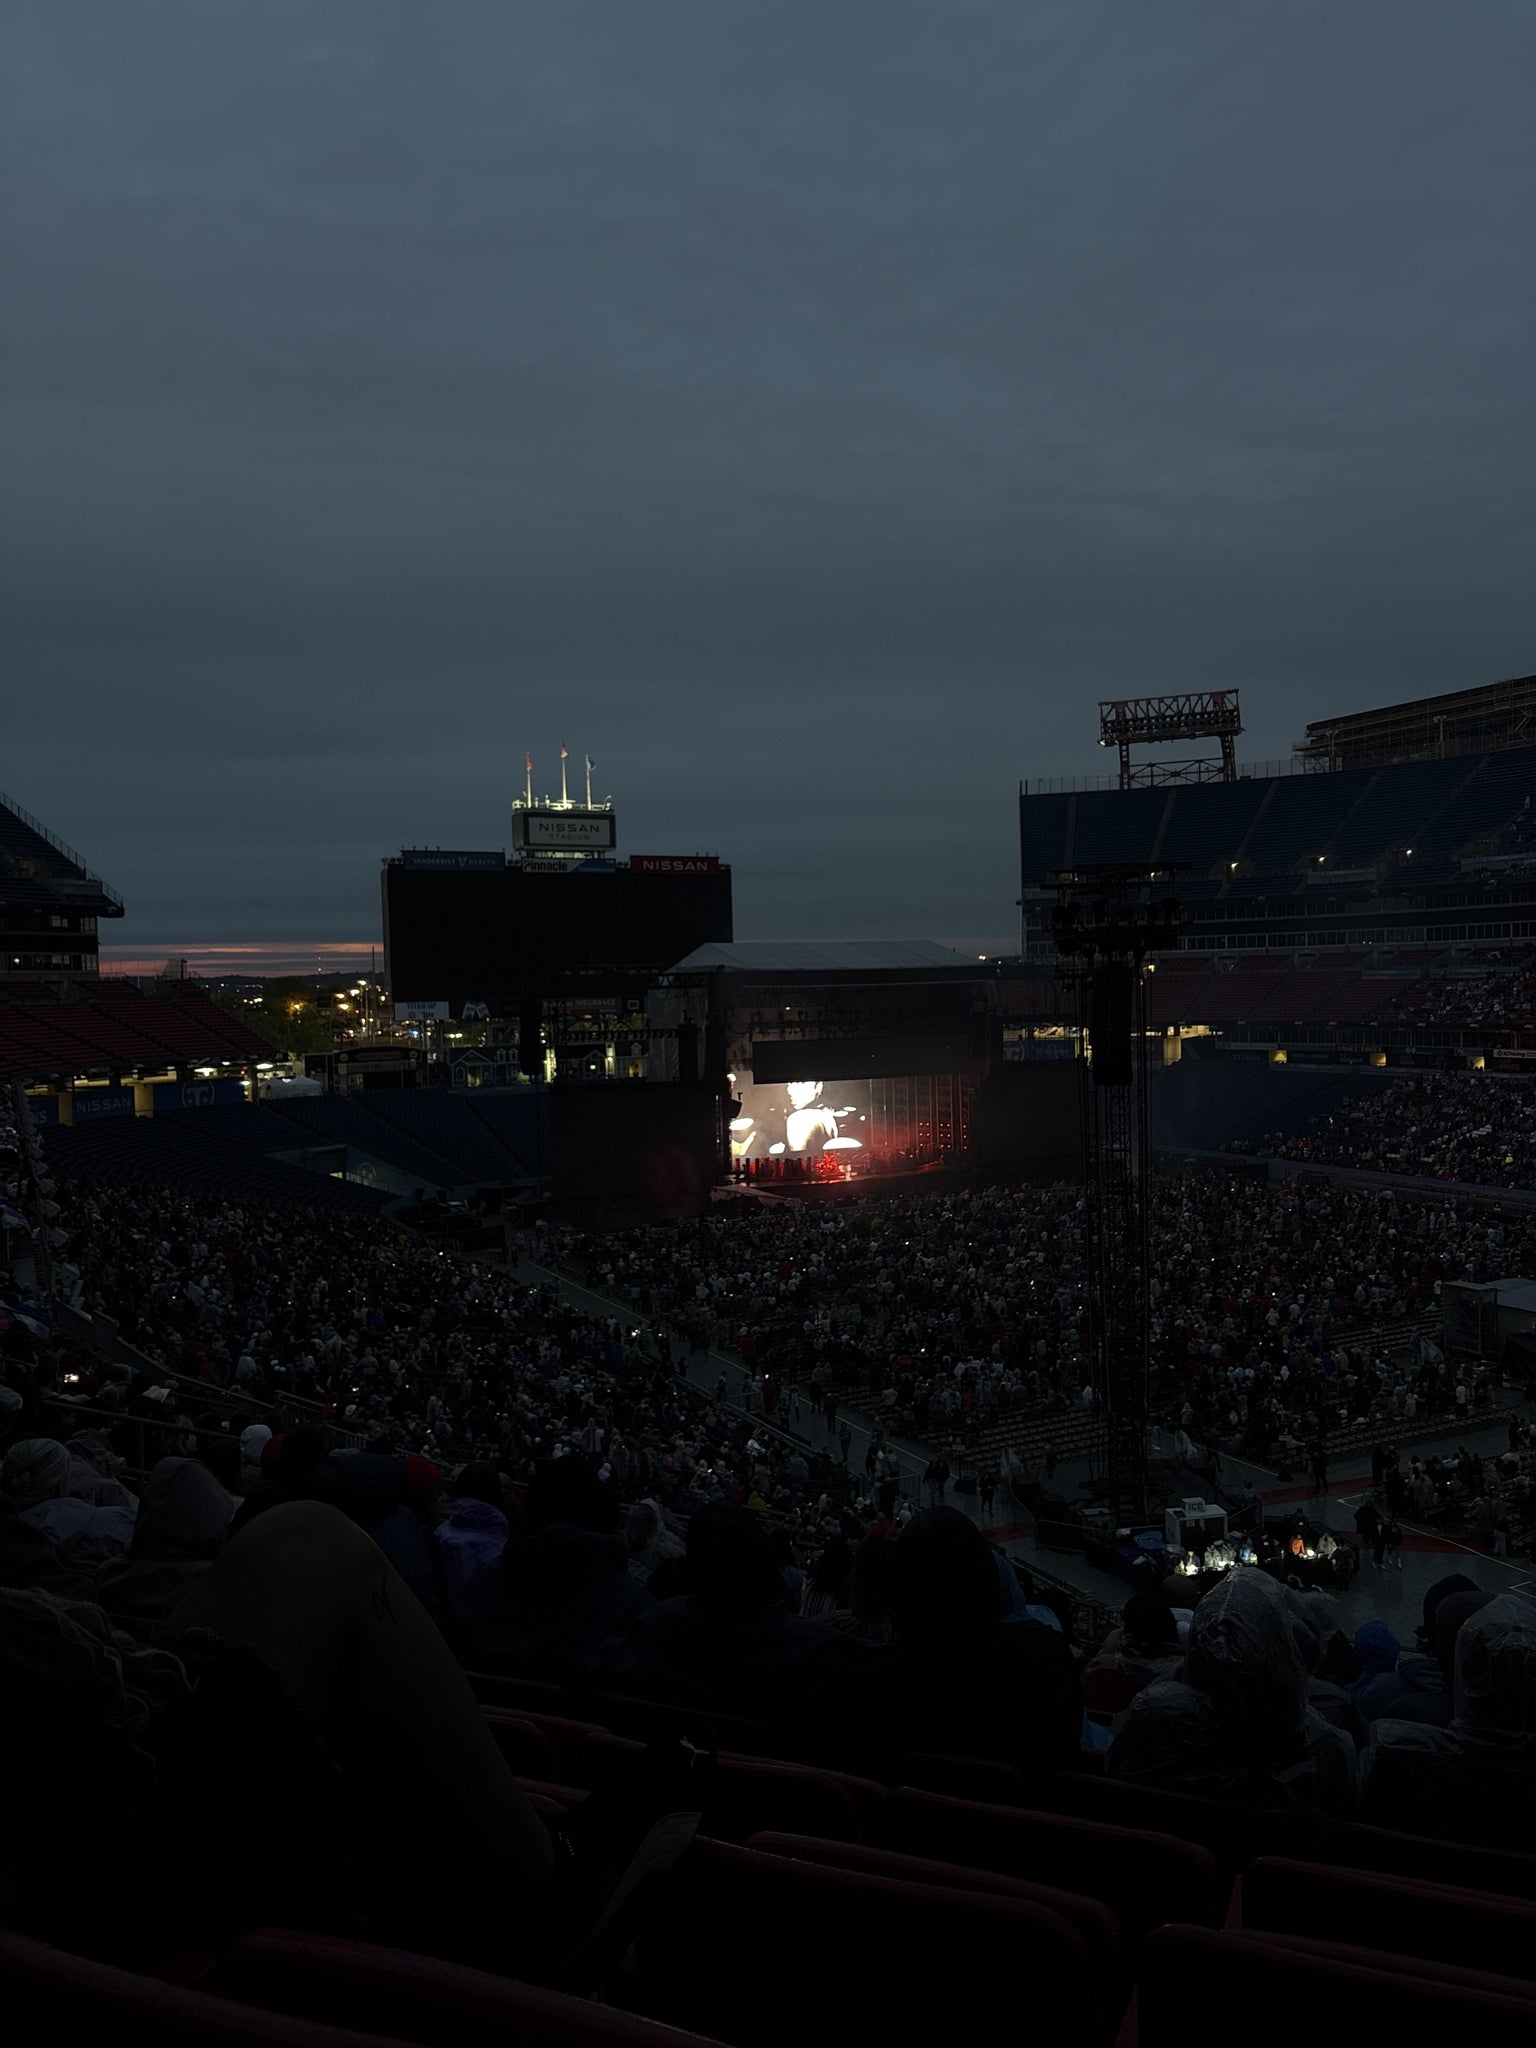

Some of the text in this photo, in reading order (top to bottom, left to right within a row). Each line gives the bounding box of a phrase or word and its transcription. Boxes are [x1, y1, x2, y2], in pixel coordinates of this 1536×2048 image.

[539, 823, 599, 833] NISSAN
[549, 833, 591, 841] STADIUM
[523, 860, 568, 871] Pinnacle
[642, 860, 708, 871] NISSAN
[76, 1096, 131, 1113] NISSAN
